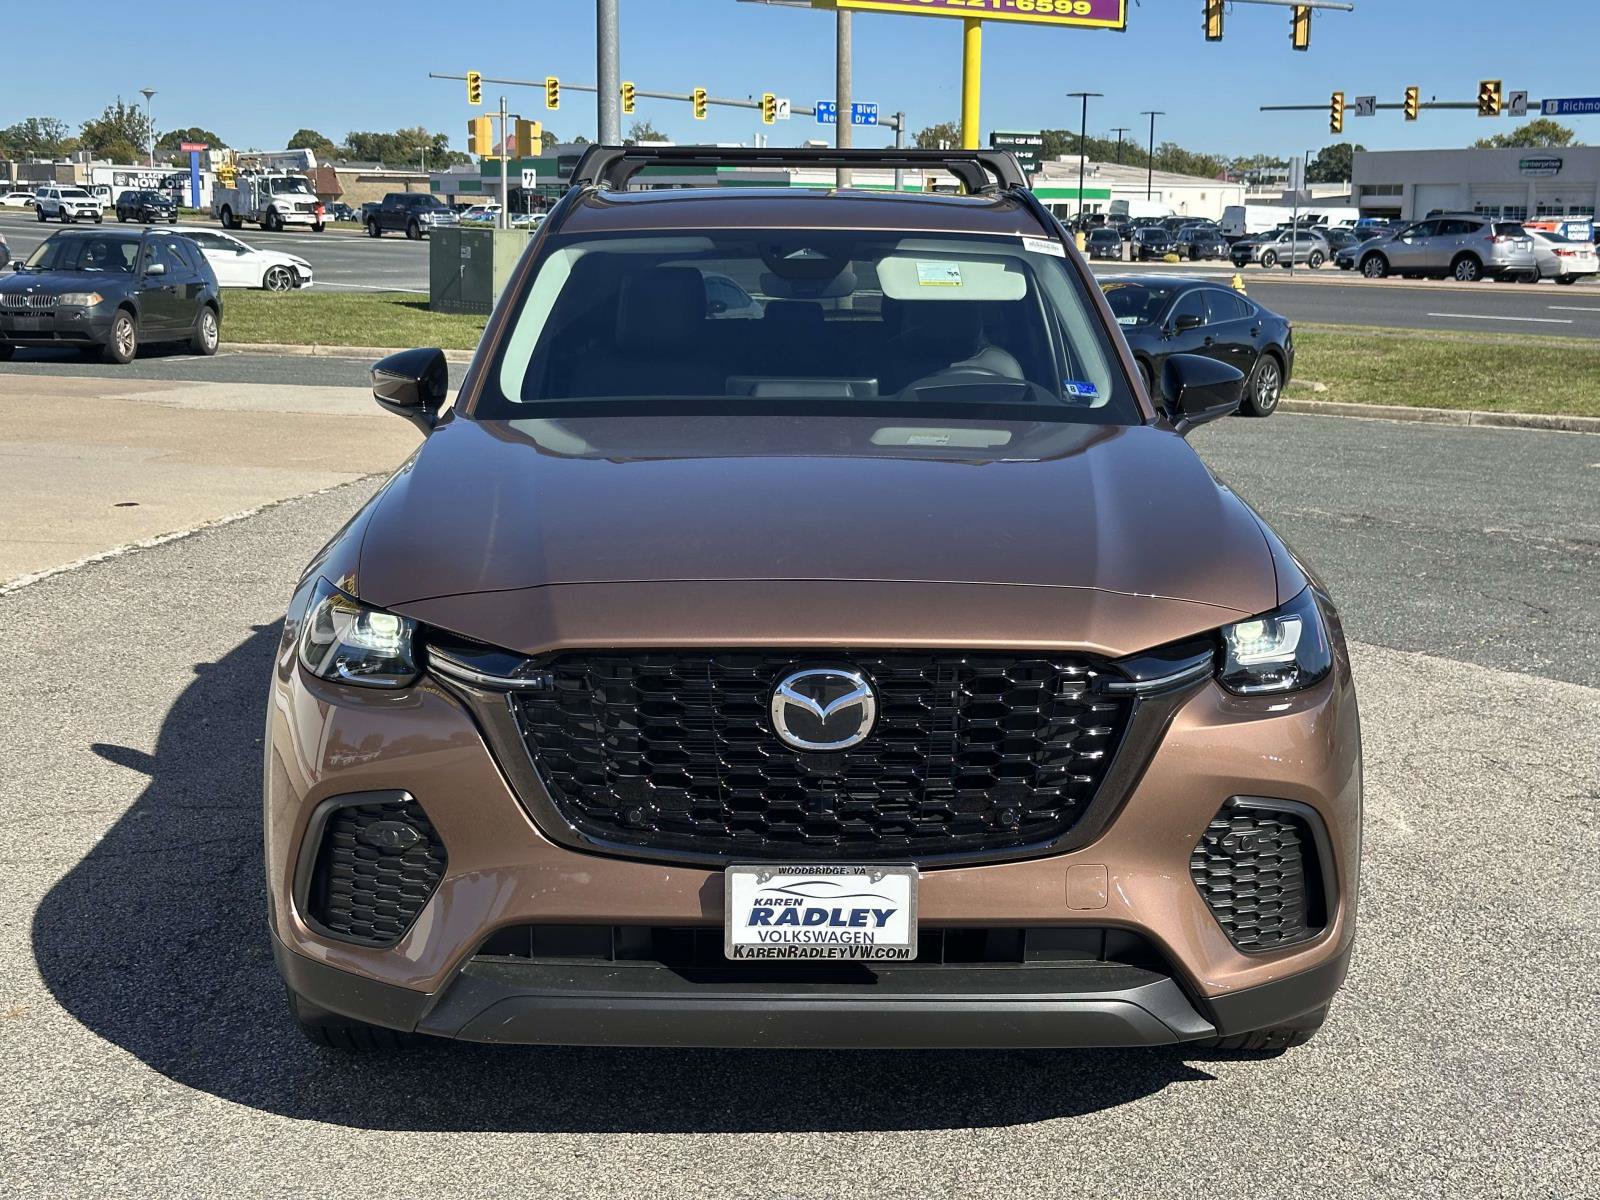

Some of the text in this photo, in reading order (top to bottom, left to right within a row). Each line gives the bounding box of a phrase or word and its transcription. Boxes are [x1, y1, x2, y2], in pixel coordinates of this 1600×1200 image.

[857, 104, 877, 114] Blvd
[855, 115, 866, 123] Dr
[137, 172, 164, 180] BLACK
[128, 177, 161, 188] NOW
[853, 867, 866, 875] VA
[753, 898, 804, 907] KAREN
[747, 907, 898, 928] RADLEY
[758, 930, 875, 944] VOLKSWAGEN
